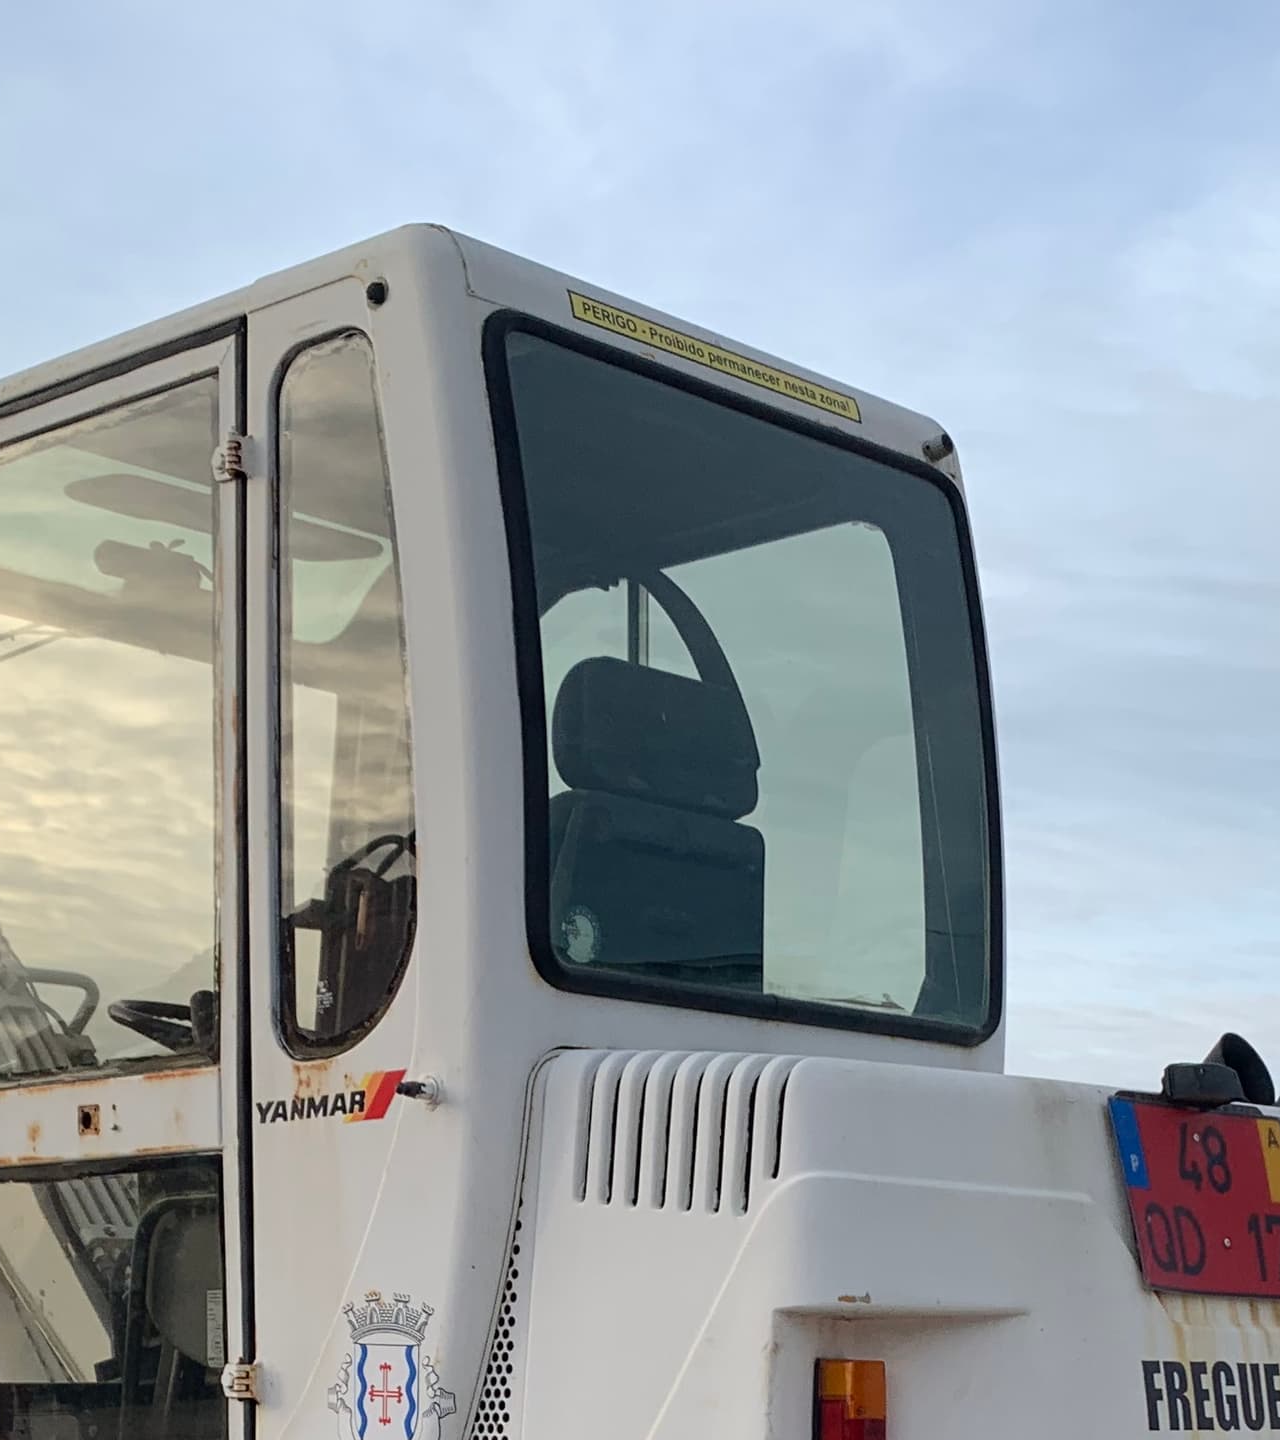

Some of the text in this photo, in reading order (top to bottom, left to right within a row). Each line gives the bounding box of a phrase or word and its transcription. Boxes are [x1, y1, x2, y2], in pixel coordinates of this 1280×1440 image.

[581, 300, 638, 334] PERIGO
[649, 327, 705, 360] Proibido
[707, 350, 781, 387] permanecer
[783, 378, 817, 401] nesta
[818, 391, 851, 413] zona!
[255, 1090, 366, 1124] YANMAR
[1178, 1122, 1280, 1194] 48 A
[1144, 1202, 1207, 1277] QD
